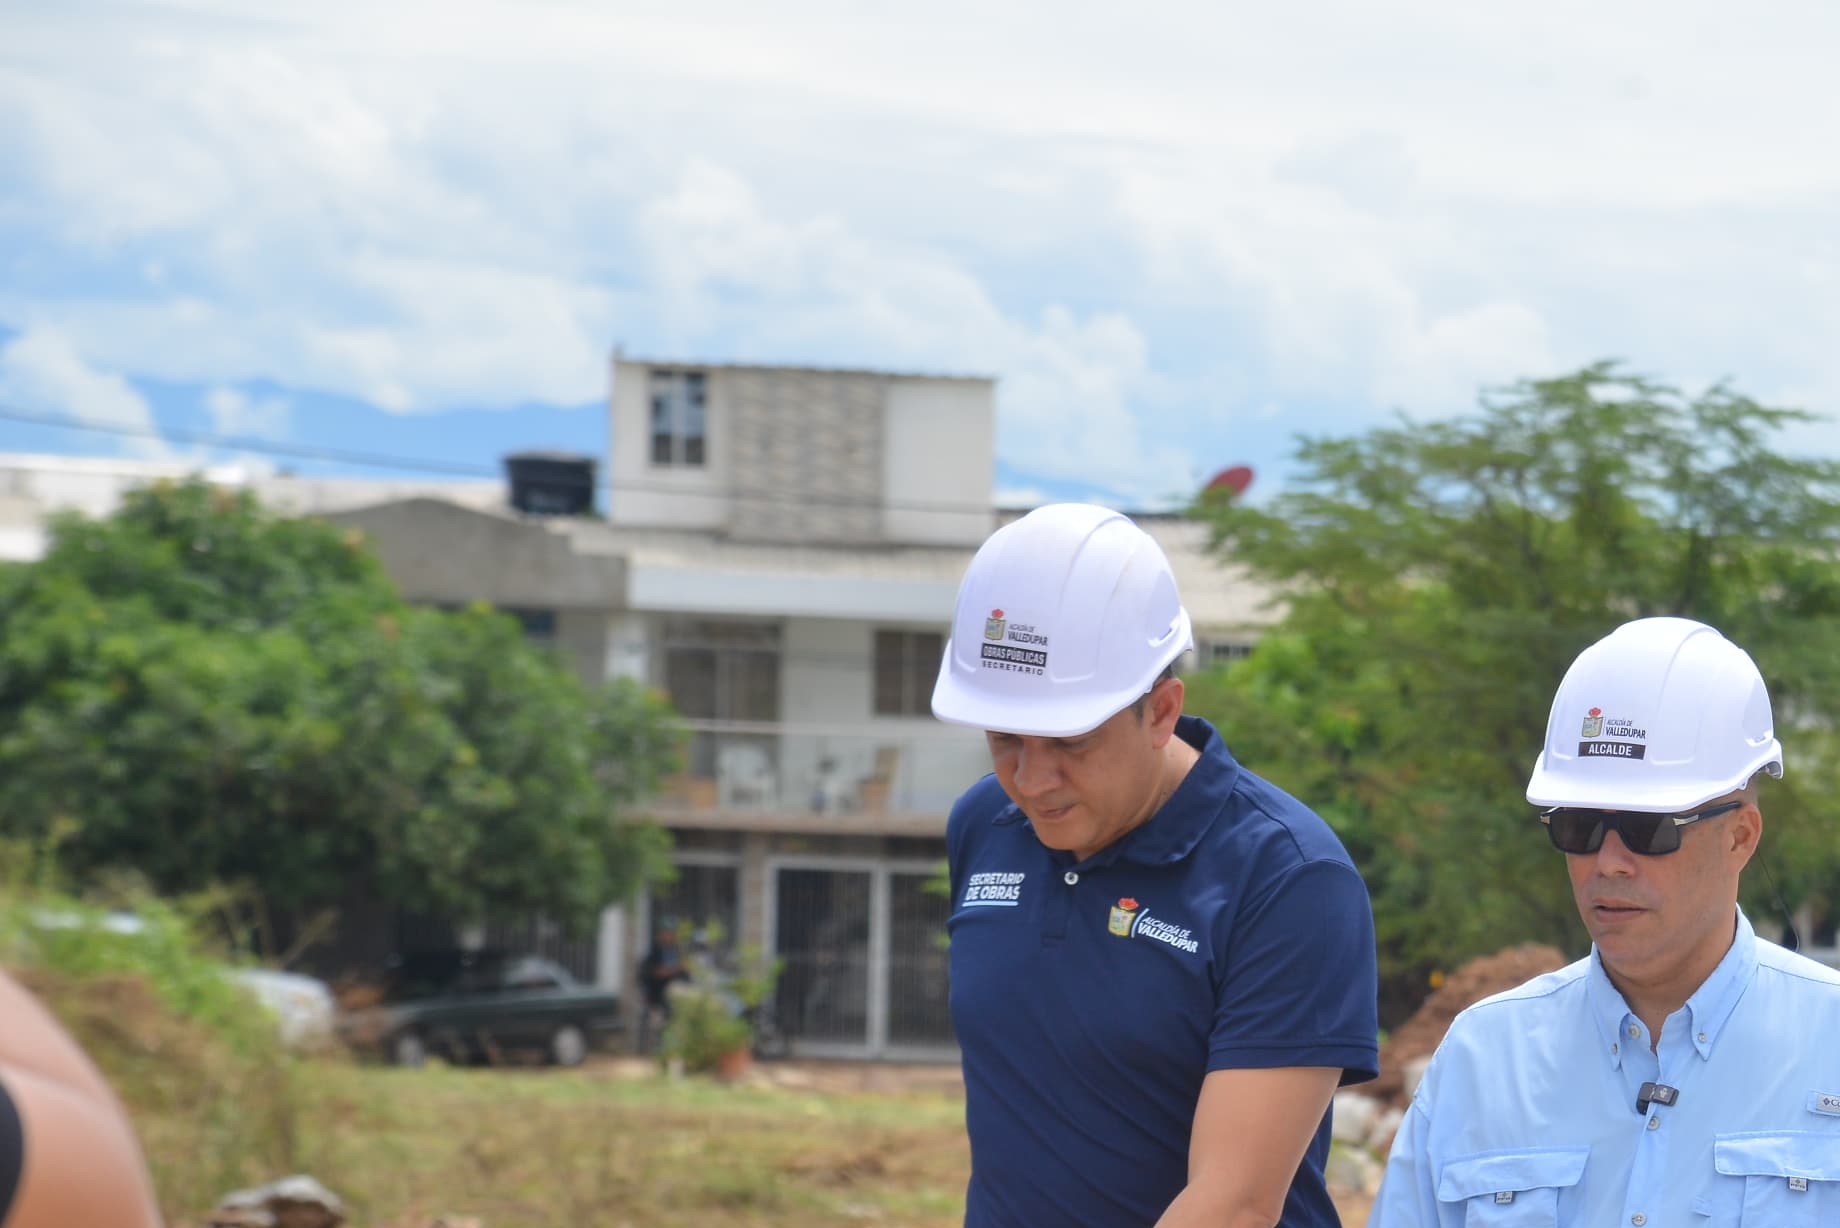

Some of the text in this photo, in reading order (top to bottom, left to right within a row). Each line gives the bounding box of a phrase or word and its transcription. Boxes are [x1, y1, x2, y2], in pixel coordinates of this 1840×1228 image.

[1008, 631, 1048, 645] VALLEDUPAR
[983, 646, 1045, 664] OBRAS PÚBLICAS
[983, 661, 1043, 675] SECRETARIO
[1606, 727, 1646, 739] VALLEDUPAR
[1588, 743, 1633, 756] ALCALDE
[969, 872, 1025, 886] SECRETARIO
[965, 885, 1021, 901] DE OBRAS
[1141, 916, 1191, 939] ALCALDÍA DE
[1137, 922, 1199, 953] VALLEDUPAR
